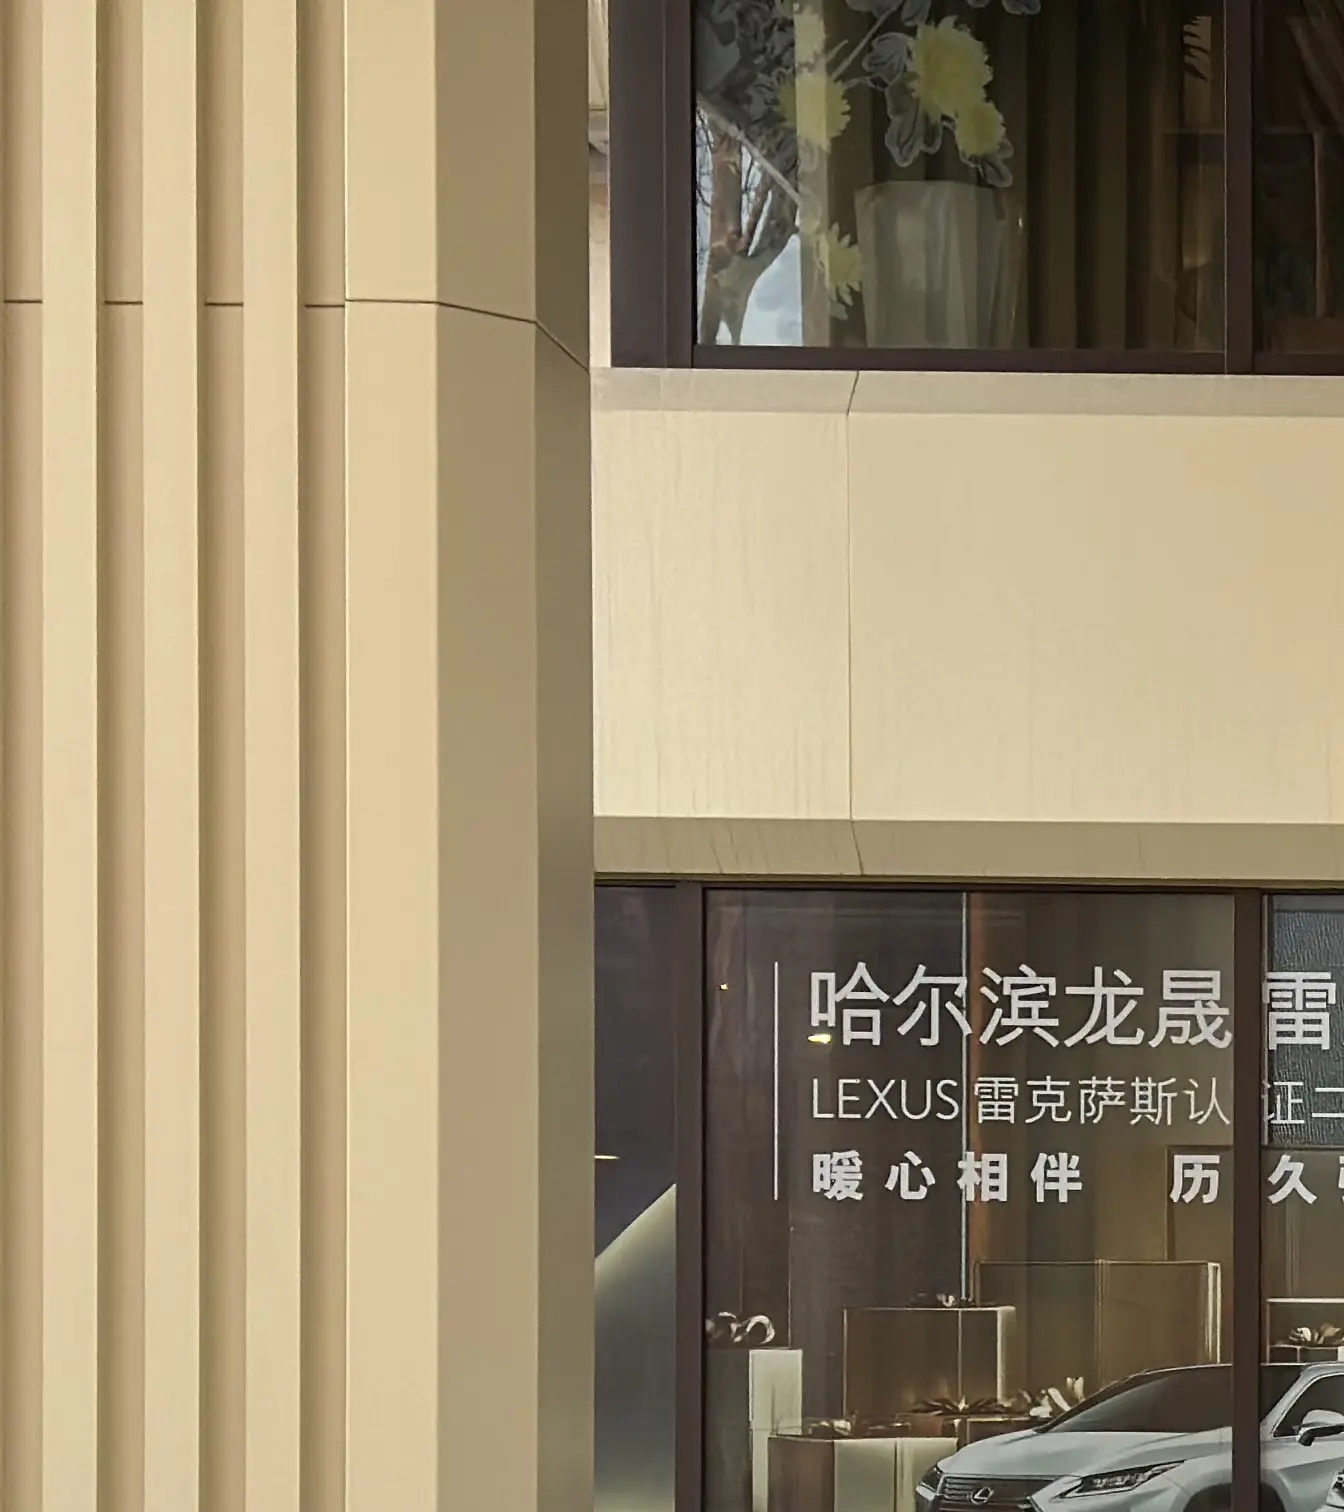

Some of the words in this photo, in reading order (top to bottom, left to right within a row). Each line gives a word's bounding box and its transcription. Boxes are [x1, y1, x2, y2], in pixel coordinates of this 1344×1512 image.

[810, 962, 1231, 1049] 哈尔滨龙晟
[812, 1078, 959, 1120] LEXUS
[812, 1150, 1084, 1204] 暖心相伴
